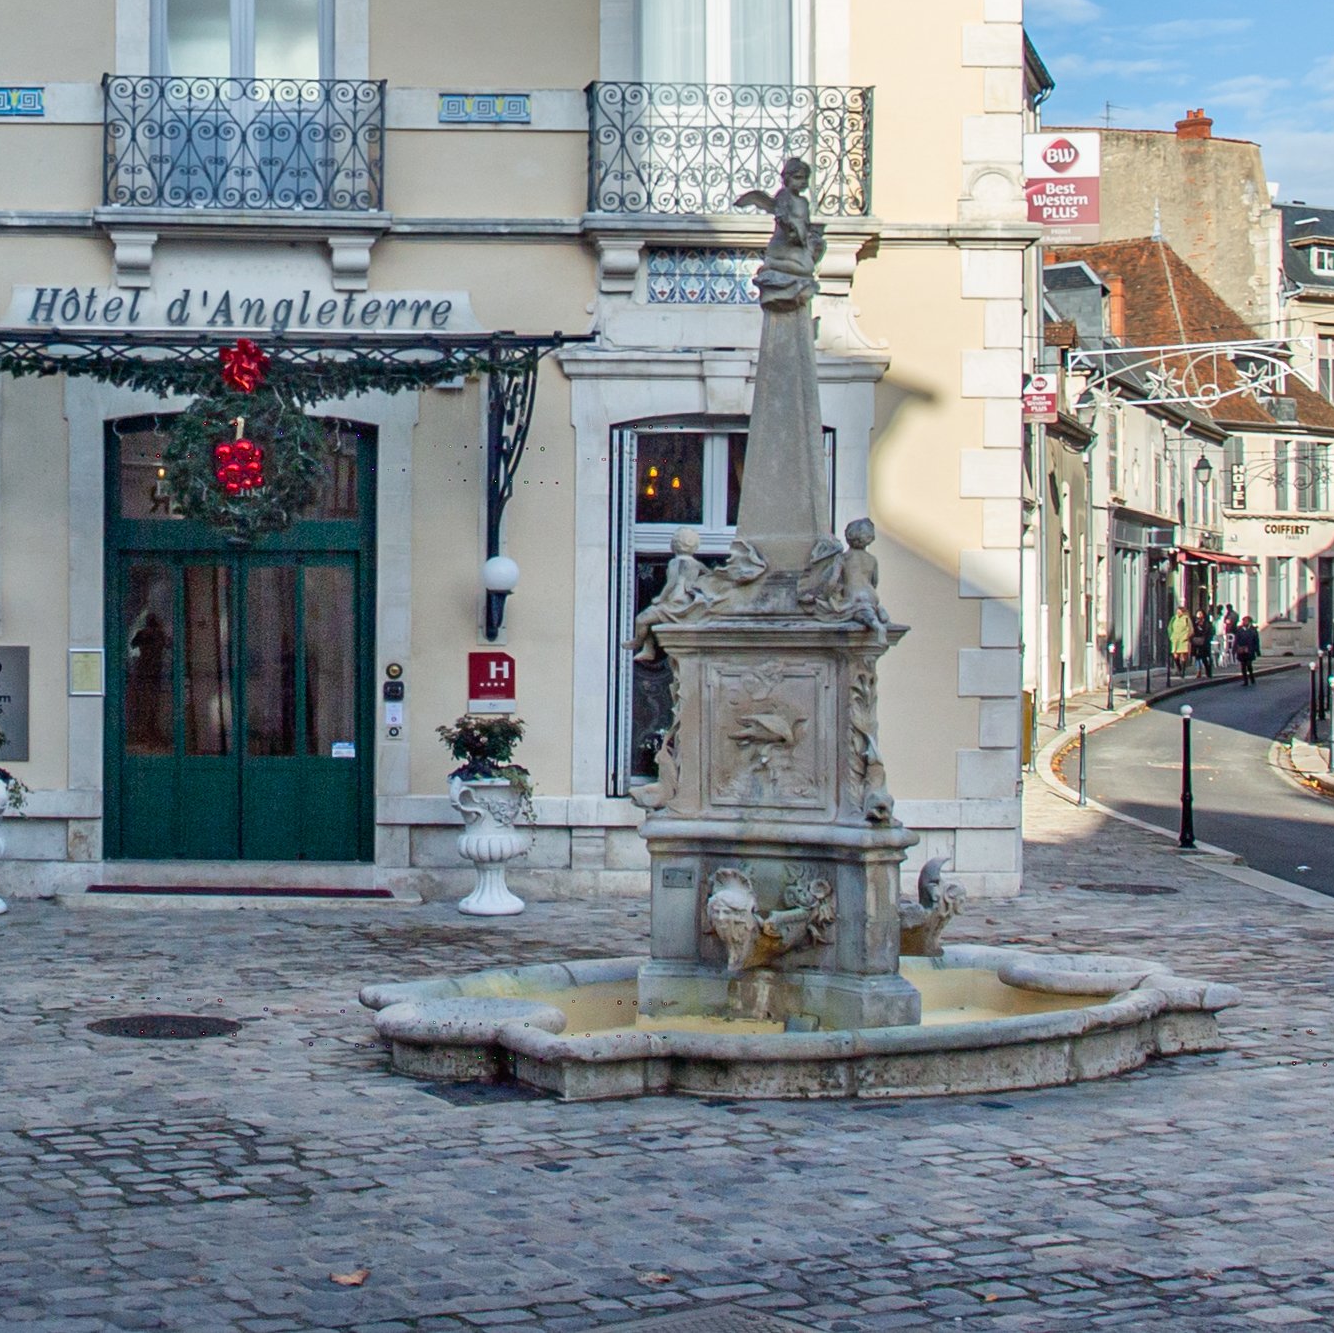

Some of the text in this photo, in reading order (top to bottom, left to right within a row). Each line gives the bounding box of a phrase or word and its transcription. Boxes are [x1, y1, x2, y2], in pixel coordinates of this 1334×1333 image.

[1046, 148, 1075, 163] BW
[1046, 183, 1075, 195] Best
[1032, 194, 1088, 206] Western
[1043, 207, 1078, 218] PLUS
[28, 286, 453, 333] Hôtel d'Angleterre
[1232, 465, 1245, 509] HOTEL
[490, 660, 510, 679] H
